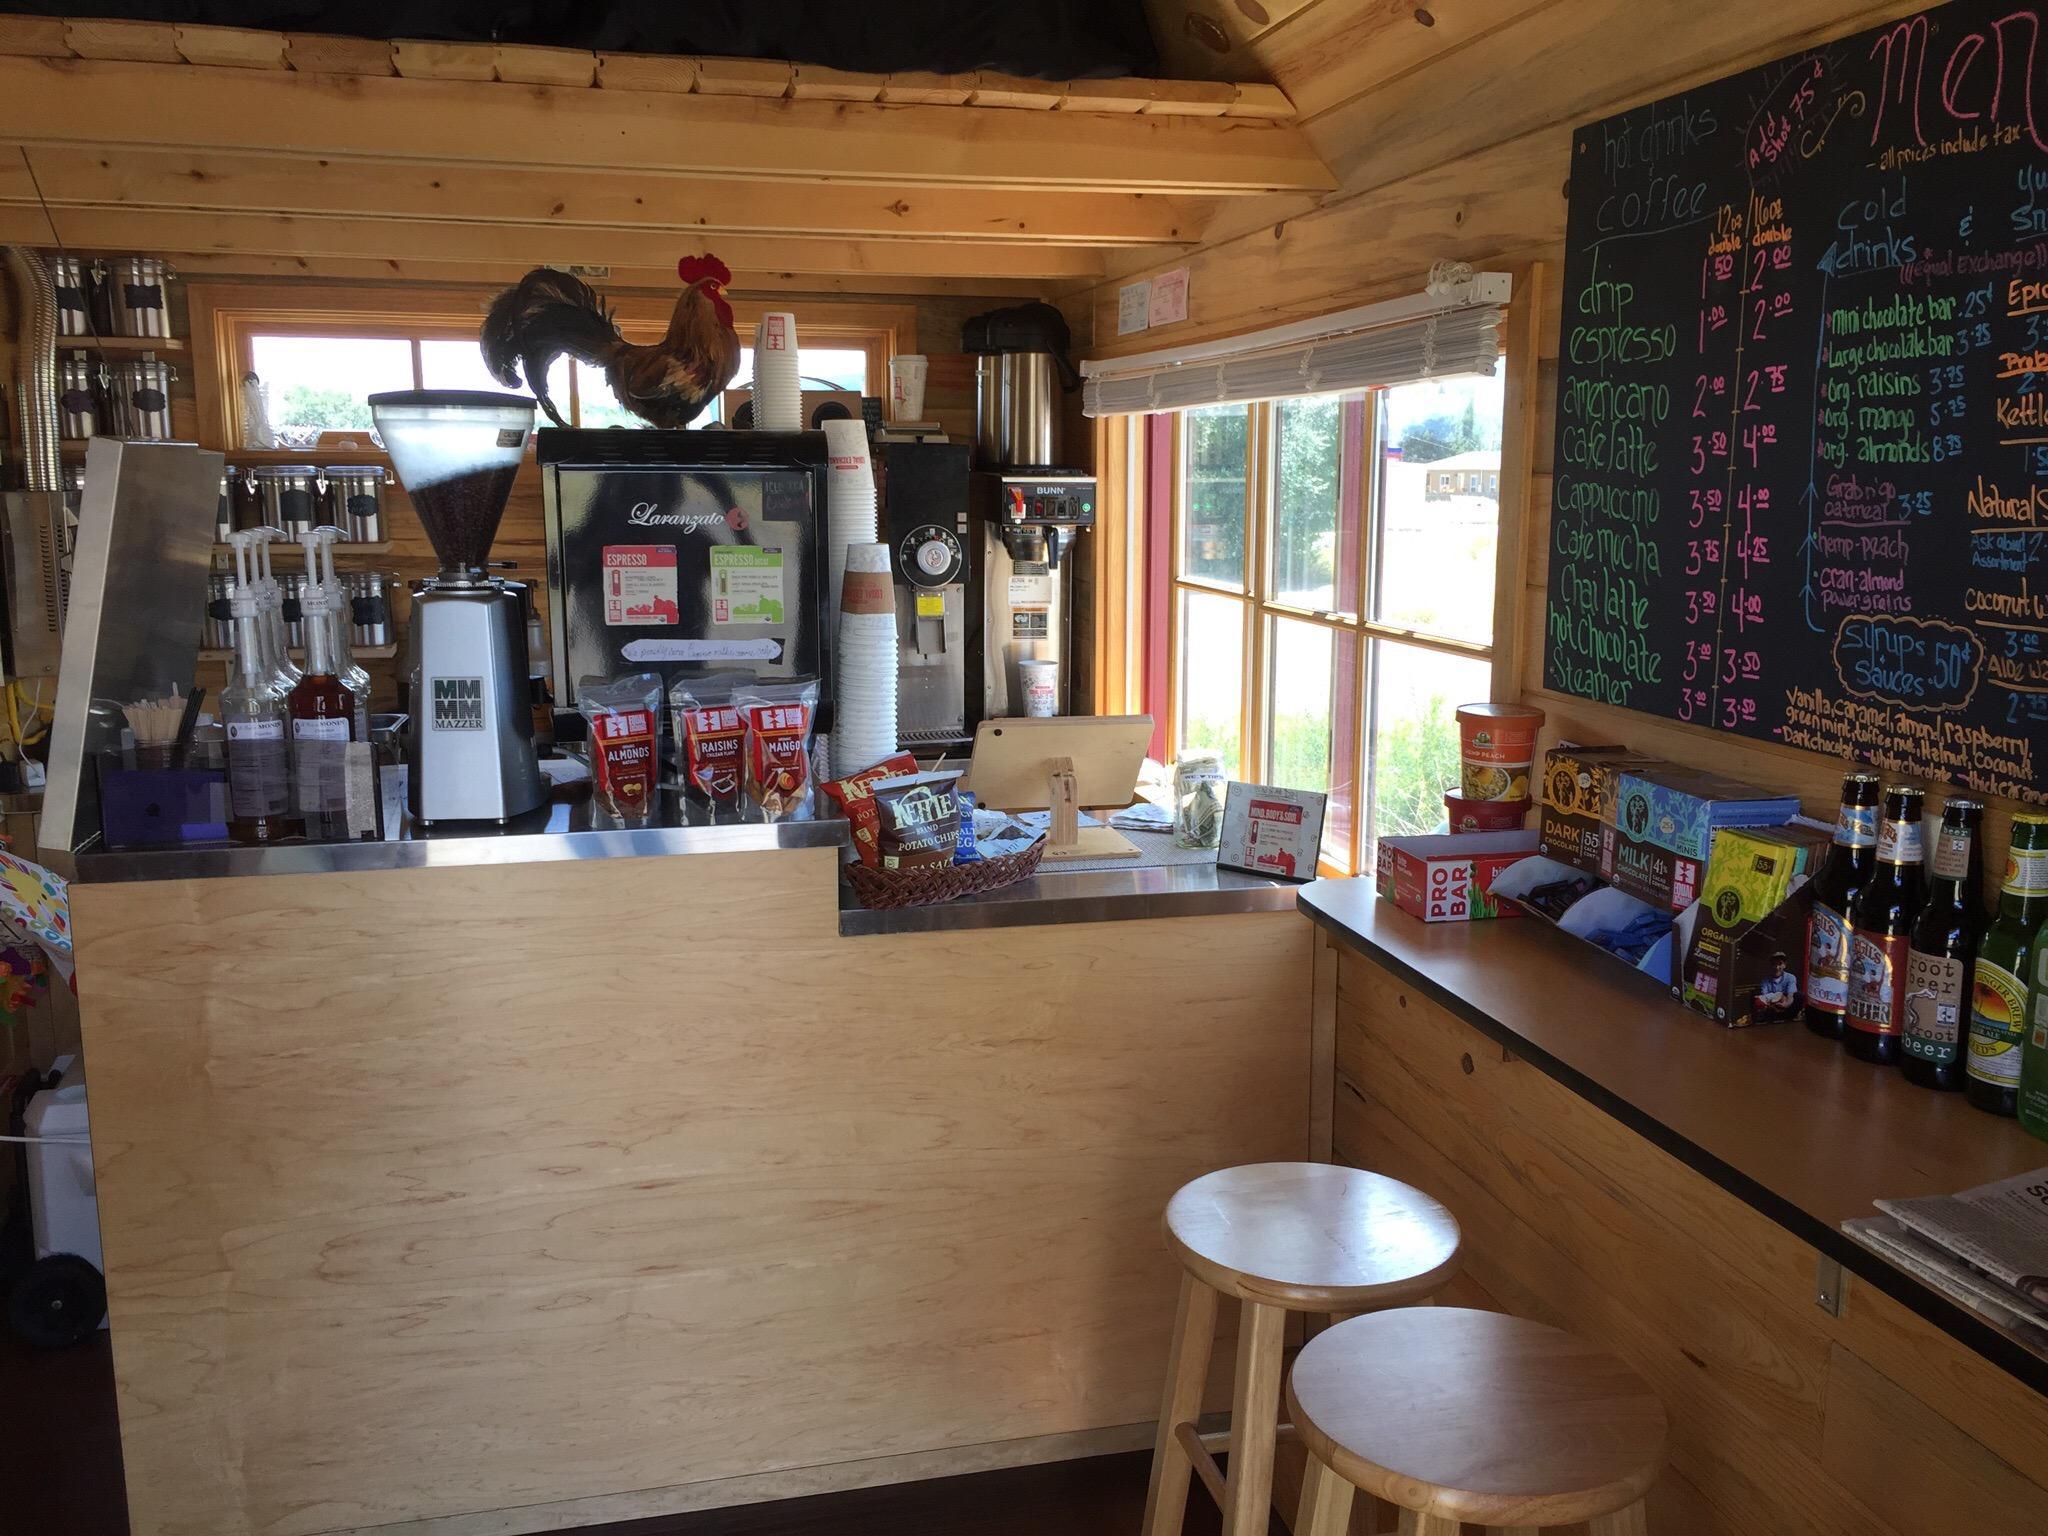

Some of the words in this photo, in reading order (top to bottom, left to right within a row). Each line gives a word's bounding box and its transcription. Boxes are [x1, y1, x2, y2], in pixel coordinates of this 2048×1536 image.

[1640, 99, 1718, 162] drinks
[1880, 146, 1896, 171] all
[1897, 143, 1937, 170] prices
[1940, 126, 1988, 156] include
[1993, 121, 2022, 146] tax
[1752, 224, 1793, 247] double
[1835, 224, 1918, 270] drinks
[1579, 245, 1634, 329] drip
[1862, 293, 1927, 330] chocolate
[1928, 294, 1957, 323] bar
[1569, 323, 1677, 378] espresso
[1928, 326, 1954, 357] bar
[1857, 367, 1921, 399] raisins
[1563, 373, 1670, 428] americano
[1859, 405, 1915, 441] mango
[1856, 431, 1931, 464] almonds
[1036, 486, 1064, 495] BUNN
[1967, 474, 2038, 527] Natural
[628, 502, 726, 535] Laranzato
[1823, 500, 1889, 521] oatmeal
[607, 553, 648, 566] ESPRESSO
[714, 553, 754, 566] ESPRESSO
[1841, 623, 1926, 674] Syrups
[1553, 646, 1633, 706] Steamer
[1855, 659, 1925, 697] Sauces
[434, 719, 483, 729] MAZZER
[608, 746, 650, 762] ALMONDS
[701, 739, 739, 754] RAISINS
[768, 740, 801, 753] MANGO
[1481, 751, 1506, 760] PEACH
[888, 785, 959, 832] KETTLE
[898, 838, 935, 852] POTATO
[934, 829, 960, 848] CHIPS
[1544, 836, 1580, 853] CHOCOLATE
[1545, 819, 1581, 844] DARK
[1618, 843, 1650, 872] MILK
[1676, 843, 1699, 858] MINIS
[1431, 867, 1449, 917] PRO
[1450, 867, 1468, 916] BAR
[1909, 957, 1955, 979] root
[1908, 973, 1956, 995] beer
[2007, 998, 2023, 1031] BREW
[1904, 1033, 1952, 1060] beer
[1914, 1026, 1955, 1043] root
